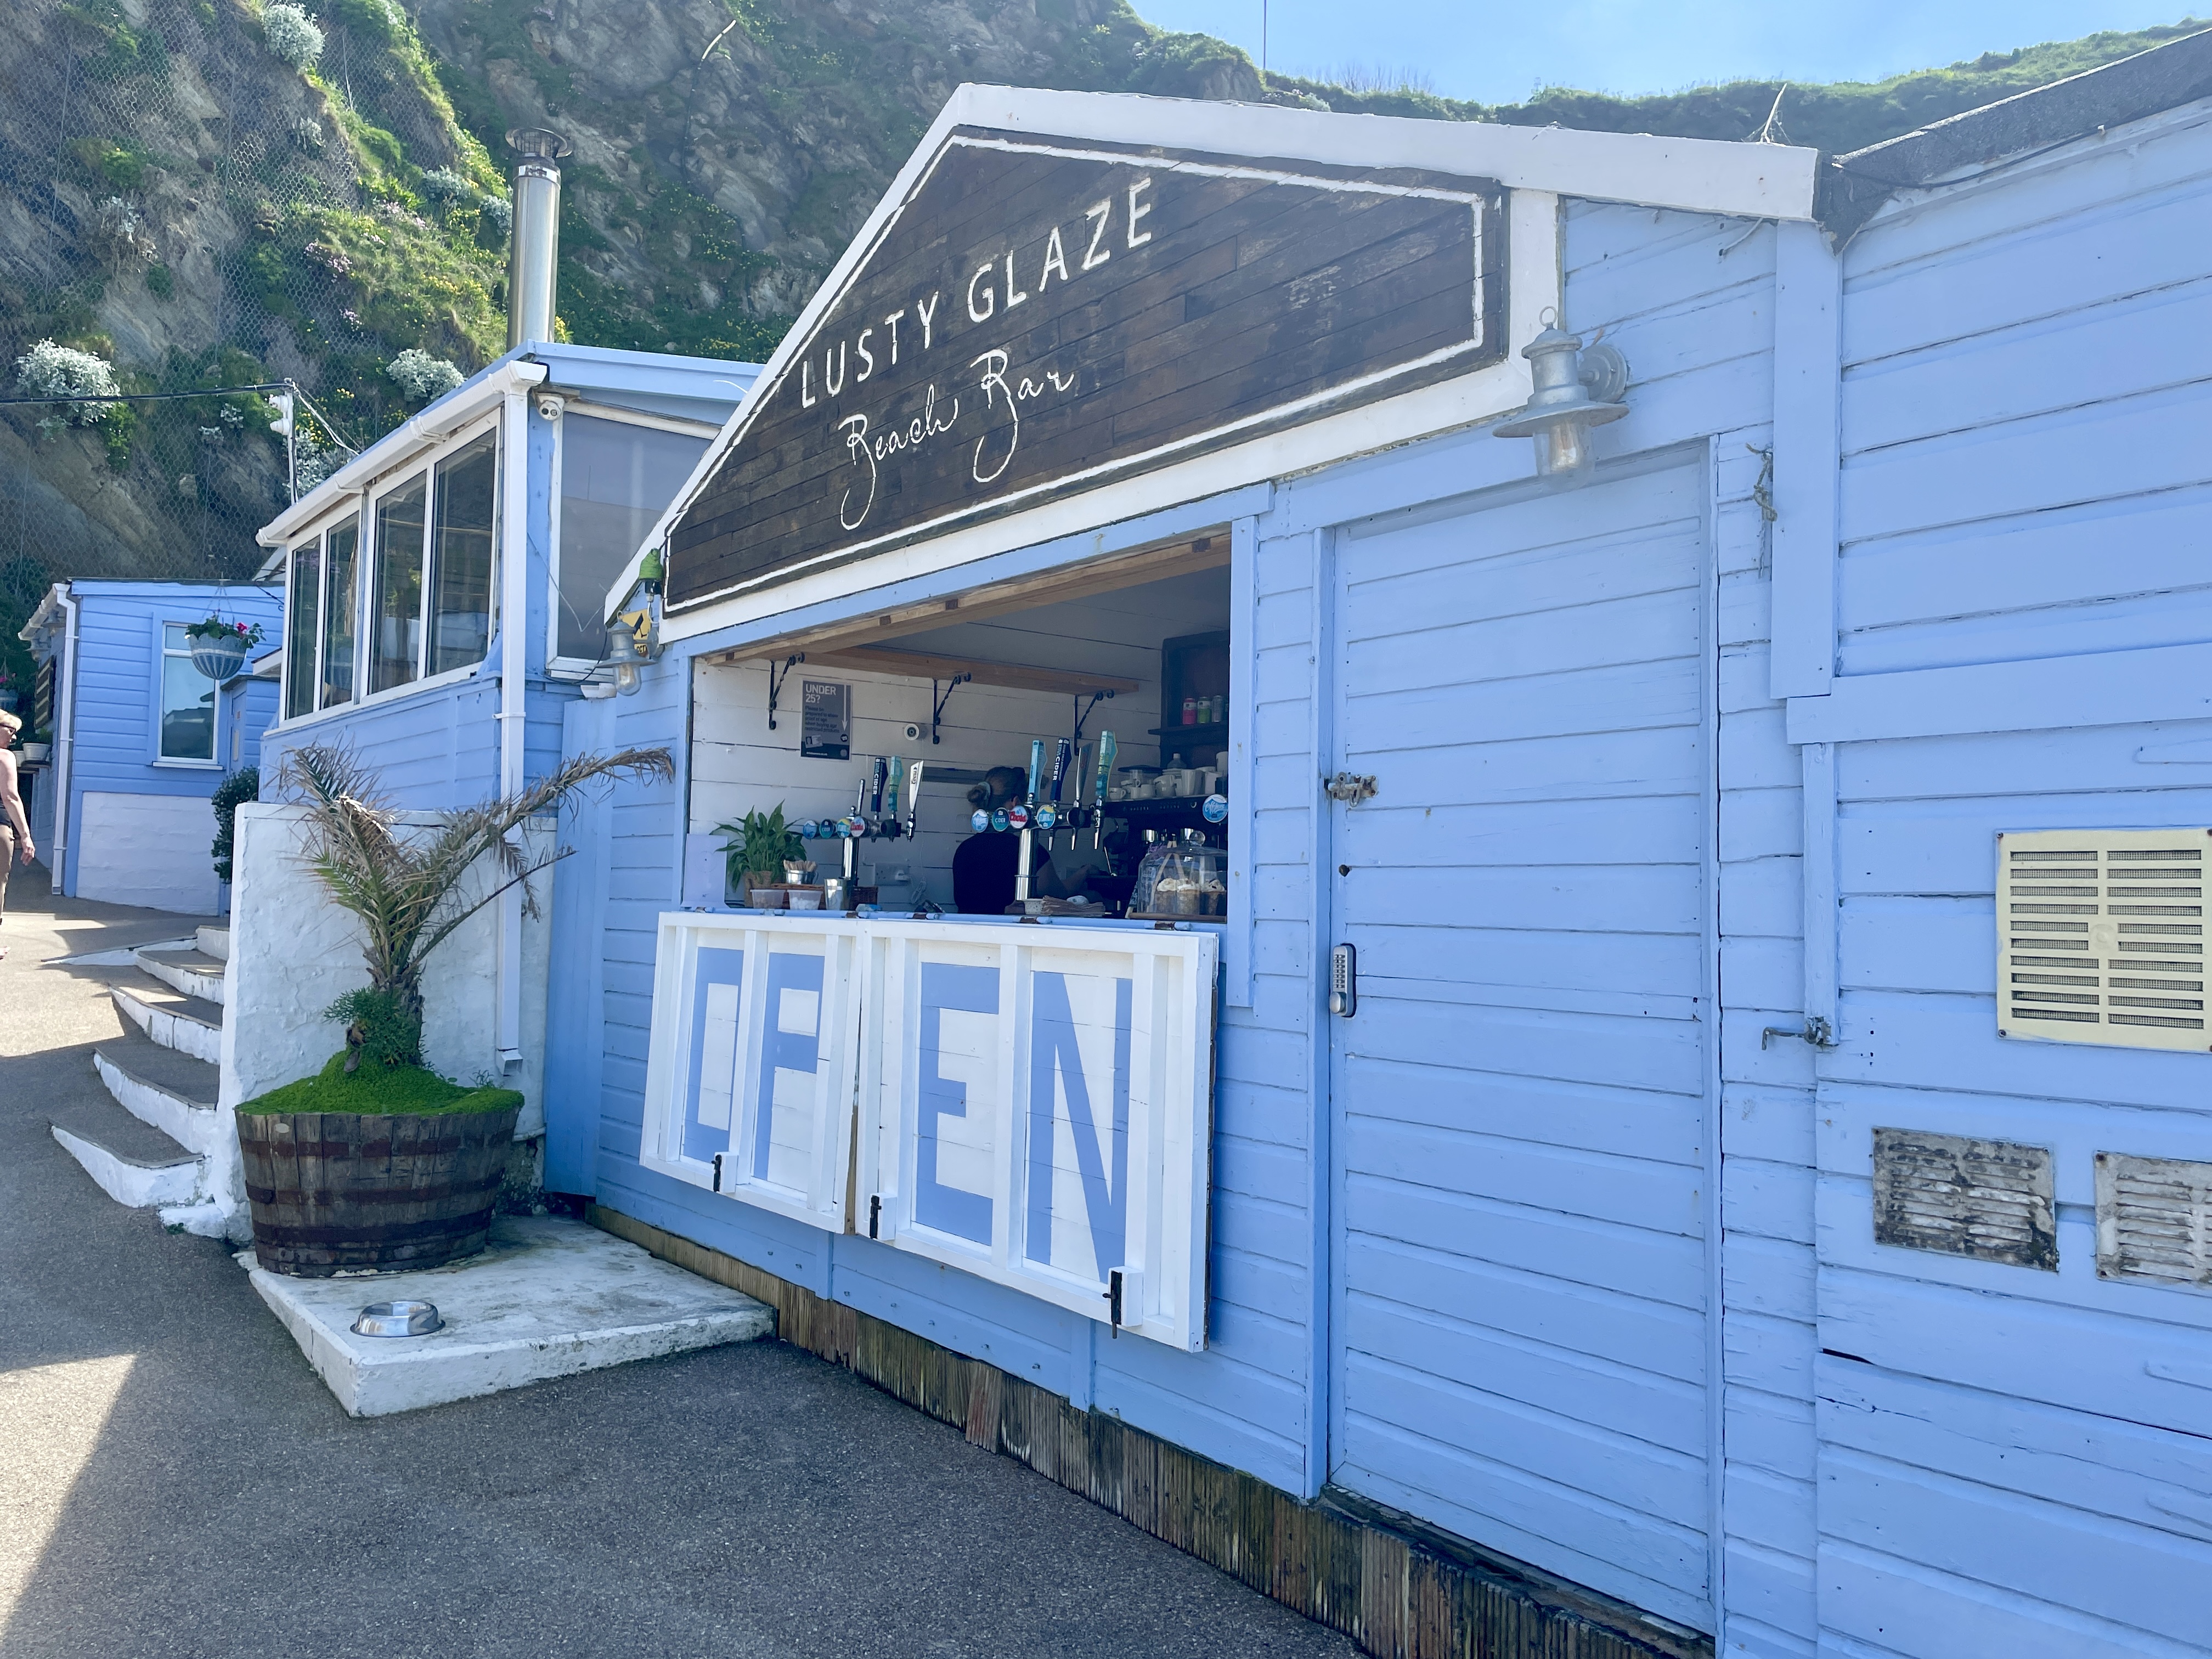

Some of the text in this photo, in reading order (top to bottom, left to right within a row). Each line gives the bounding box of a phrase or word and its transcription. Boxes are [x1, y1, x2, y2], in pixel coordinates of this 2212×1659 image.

[801, 177, 1152, 409] LUSTY GLAZE
[838, 348, 1075, 531] Beach Bar
[805, 684, 836, 696] UNDER
[805, 694, 821, 704] 25?
[680, 946, 1133, 1288] OPEN
